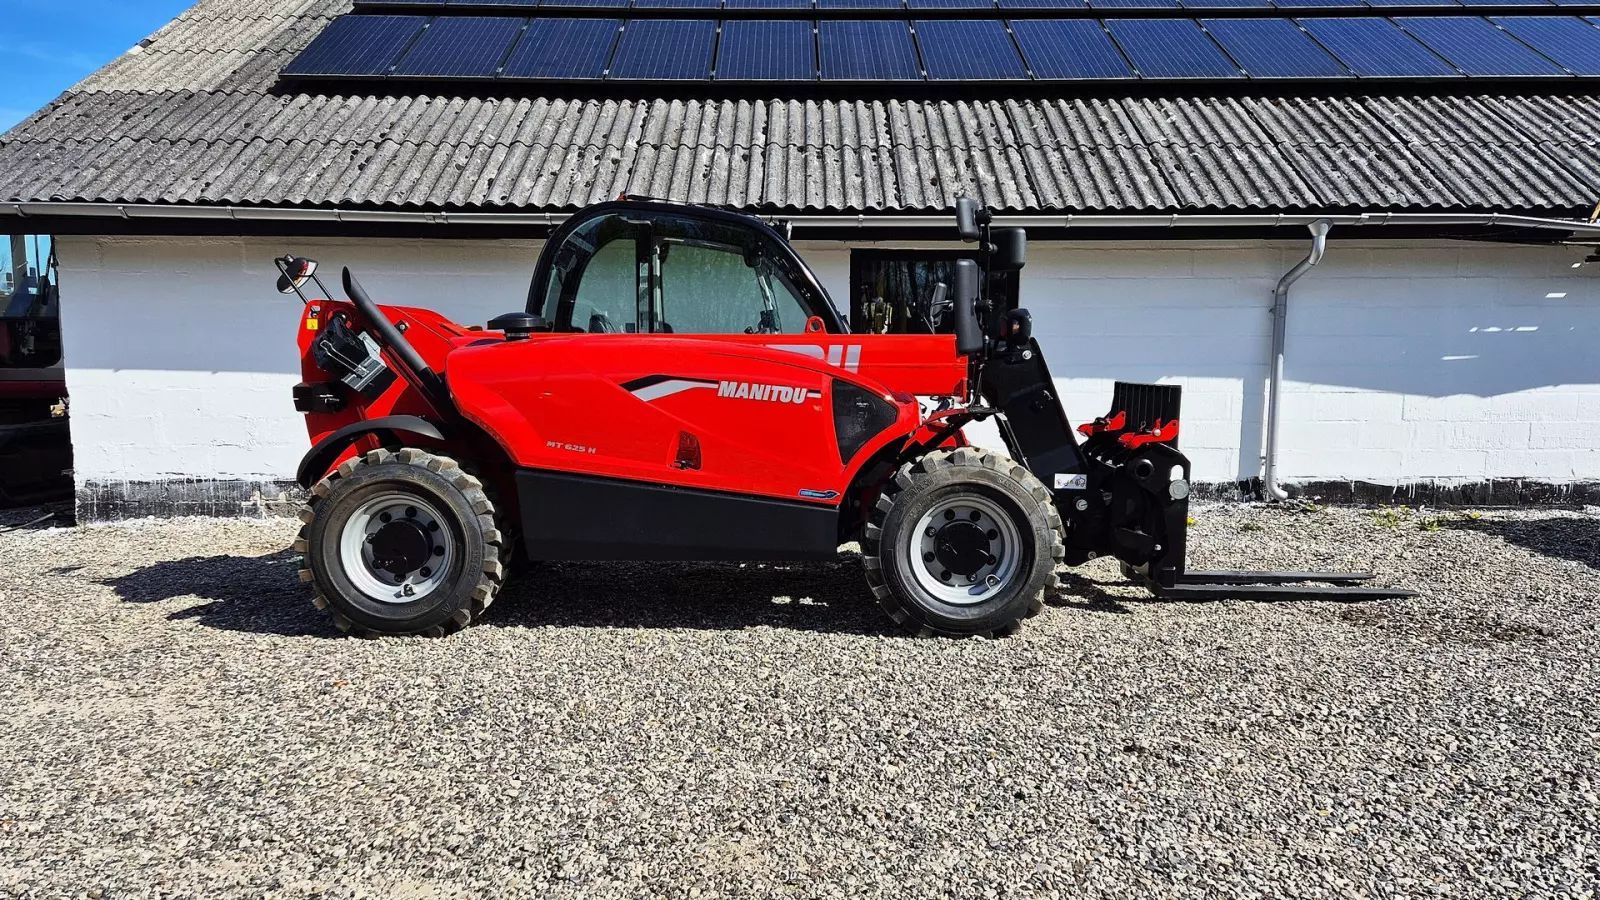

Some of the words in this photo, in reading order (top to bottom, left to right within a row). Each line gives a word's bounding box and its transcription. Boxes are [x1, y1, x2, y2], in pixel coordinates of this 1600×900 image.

[717, 380, 808, 404] MANITOU
[546, 440, 563, 449] MT
[564, 443, 586, 453] 625
